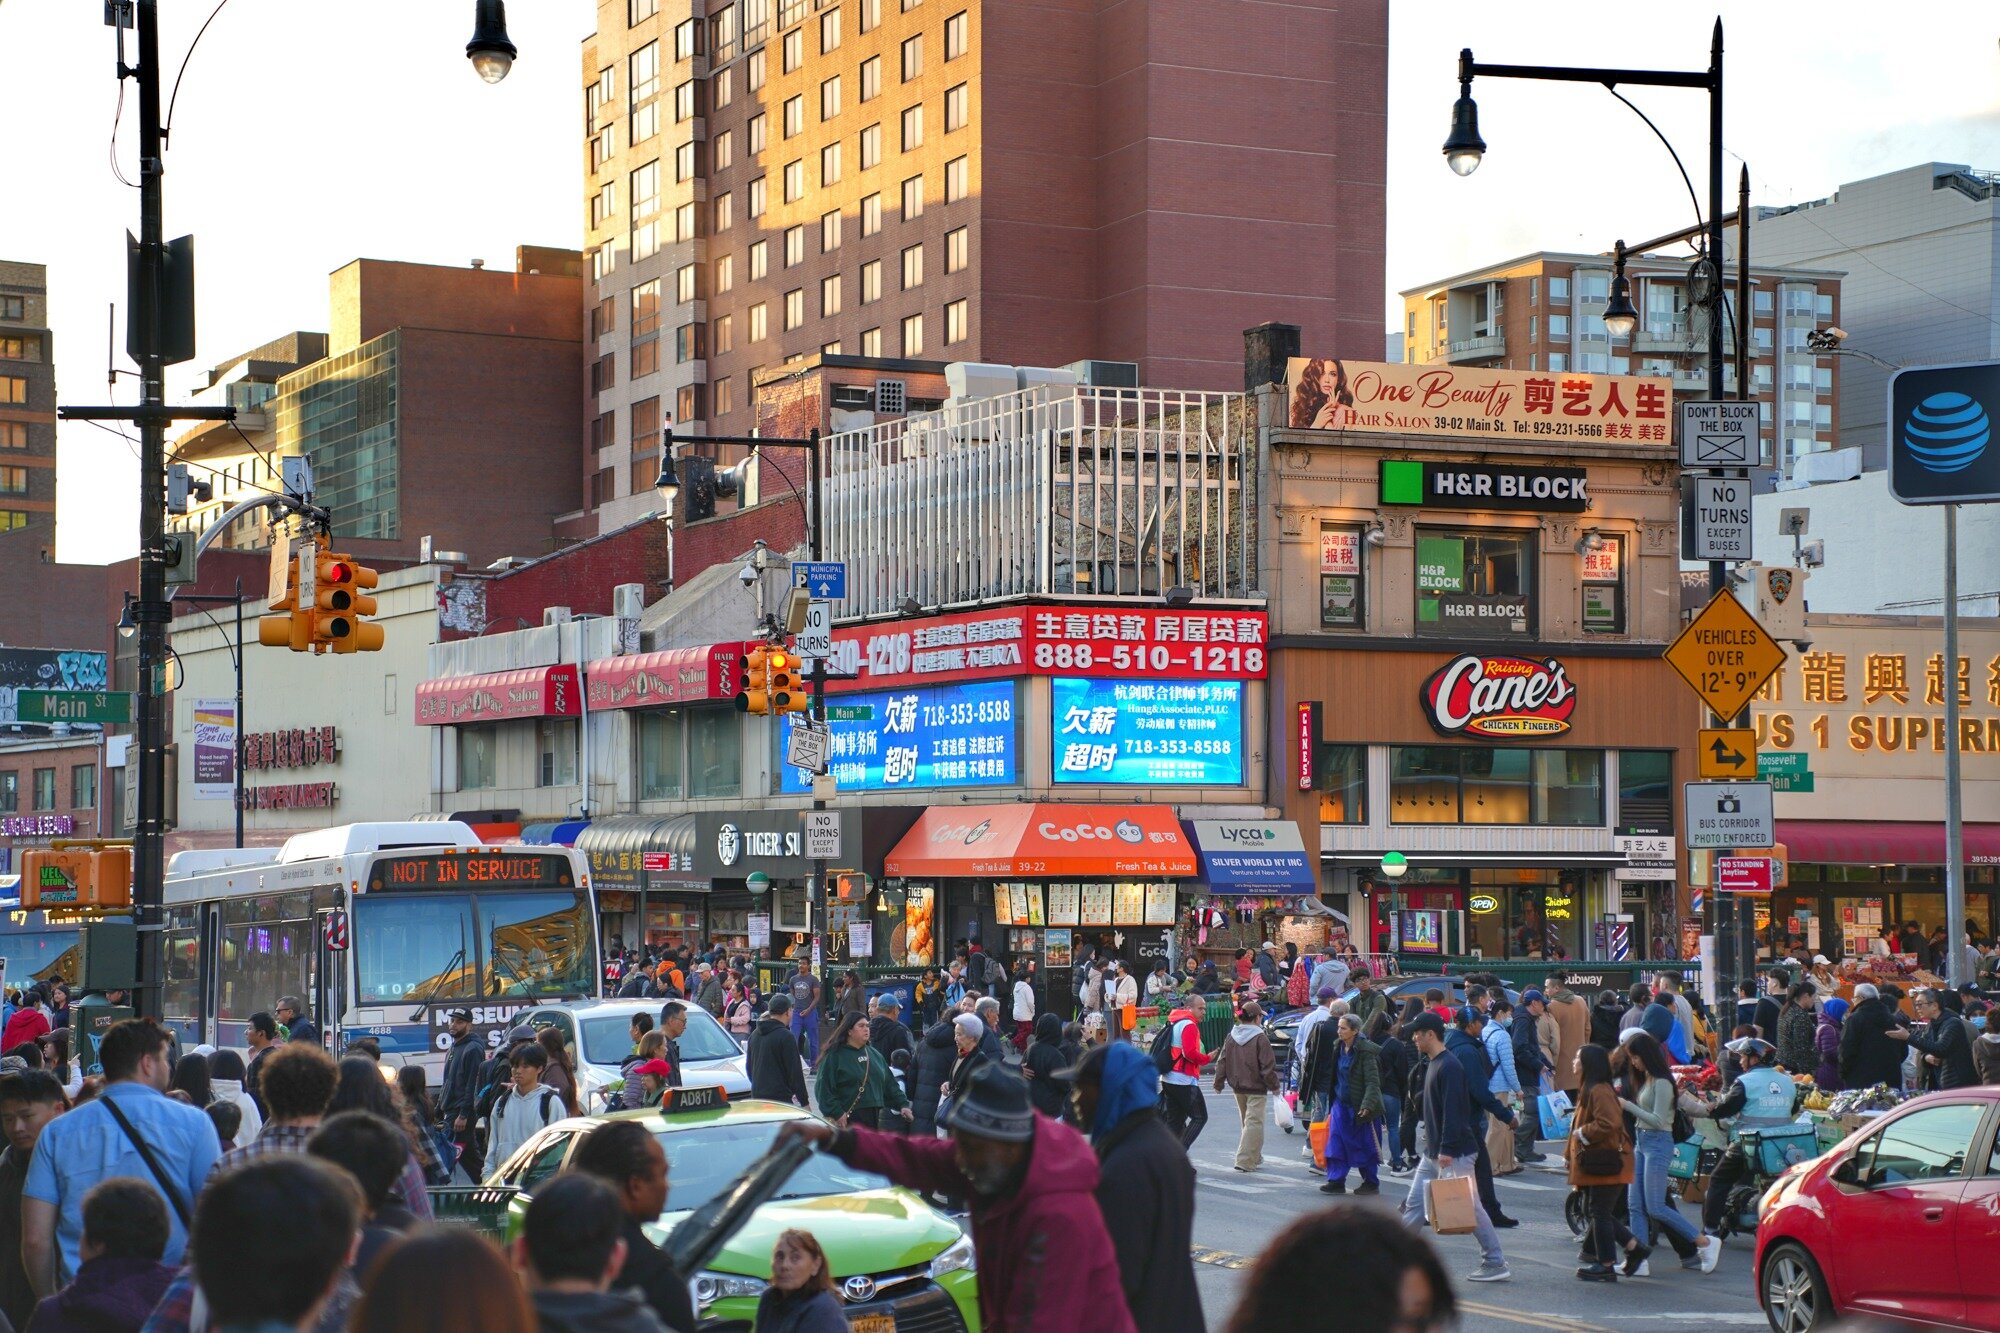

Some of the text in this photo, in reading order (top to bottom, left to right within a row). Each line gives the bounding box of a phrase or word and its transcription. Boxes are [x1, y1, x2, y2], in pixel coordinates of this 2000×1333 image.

[1353, 371, 1518, 417] One Beauty
[1524, 377, 1666, 420] 剪艺人生
[1688, 407, 1754, 418] DON'T BLOCK
[1384, 411, 1431, 429] SALON
[1434, 416, 1463, 430] 39-02
[1466, 418, 1491, 432] Main
[1494, 419, 1507, 432] St.
[1514, 420, 1531, 433] Tel:
[1534, 422, 1602, 437] 929-231-5566
[1605, 422, 1666, 440] 美发 美容
[1700, 421, 1743, 432] THE BOX
[1436, 472, 1588, 500] H&R BLOCK
[1713, 487, 1736, 503] NO
[1700, 508, 1749, 524] TURNS
[1322, 535, 1358, 547] 公司成立
[1707, 528, 1742, 538] EXCEPT
[1709, 541, 1740, 551] BUSES
[1325, 548, 1354, 564] 报税
[1585, 555, 1612, 570] 报税
[1420, 564, 1446, 576] H&R
[1420, 577, 1460, 588] BLOCK
[804, 611, 821, 627] NO
[1445, 605, 1525, 617] H&R BLOCK
[1035, 613, 1263, 643] 生意贷款 房屋贷款
[797, 636, 829, 650] TURNS
[1694, 630, 1757, 645] VEHICLES
[714, 652, 734, 661] HAIR
[1035, 643, 1264, 673] 888-510-1218
[1708, 651, 1745, 666] OVER
[1485, 661, 1533, 678] Raising
[551, 674, 569, 682] HAIR
[648, 674, 674, 696] Wave
[678, 667, 706, 685] Salon
[720, 661, 731, 696] SALON
[483, 693, 503, 713] Wave
[508, 687, 539, 704] Salon
[555, 682, 566, 713] SALON
[1114, 685, 1237, 702] 杭剑联合律师事务所
[1436, 656, 1575, 729] Cane's
[43, 694, 107, 718] Main St
[836, 708, 854, 719] Main
[923, 700, 1011, 727] 718-353-8588
[1128, 704, 1228, 716] Hang&Associate,PLLC
[883, 694, 919, 735] 欠薪
[1061, 705, 1118, 735] 欠薪
[194, 723, 220, 733] Come
[1178, 718, 1217, 730] 专精律师
[1482, 720, 1560, 731] CHICKEN FINGERS
[197, 732, 234, 744] See Us!
[793, 730, 824, 743] DON'T BLOCK
[1810, 715, 1829, 750] 1
[798, 740, 818, 749] THE BOX
[932, 735, 1005, 757] 工资追偿 法院应诉
[1125, 739, 1231, 755] 718-353-8588
[1302, 712, 1311, 775] CANE'S
[883, 744, 919, 784] 超时
[1061, 743, 1118, 772] 超时
[1758, 754, 1797, 765] Roosevelt
[968, 759, 1005, 778] 不收费用
[1766, 773, 1800, 789] Main St
[258, 782, 333, 810] SUPERMARKET
[816, 816, 830, 826] NO
[1700, 819, 1761, 829] BUS CORRIDOR
[808, 828, 839, 838] TURNS
[931, 824, 967, 843] CoCo
[1038, 822, 1113, 842] CoCo
[1148, 831, 1178, 844] 都可
[1220, 826, 1262, 842] Lyca
[1694, 834, 1767, 843] PHOTO ENFORCED
[744, 832, 783, 857] TIGER
[1623, 840, 1668, 852] 剪艺人生
[393, 858, 542, 883] NOT IN SERVICE
[886, 863, 899, 872] 39-22
[972, 863, 1011, 872] Fresh Tea & Juice
[1018, 862, 1046, 871] 39-22
[1115, 862, 1192, 871] Fresh Tea & Juice
[1211, 858, 1303, 867] SILVER WORLD NY INC
[1470, 899, 1494, 909] OPEN
[1545, 896, 1571, 907] Chicken
[10, 910, 27, 926] #7
[1138, 946, 1167, 957] CoCo
[435, 1004, 530, 1027] MSEUM
[369, 1027, 392, 1035] 4688
[680, 1089, 713, 1107] AD817
